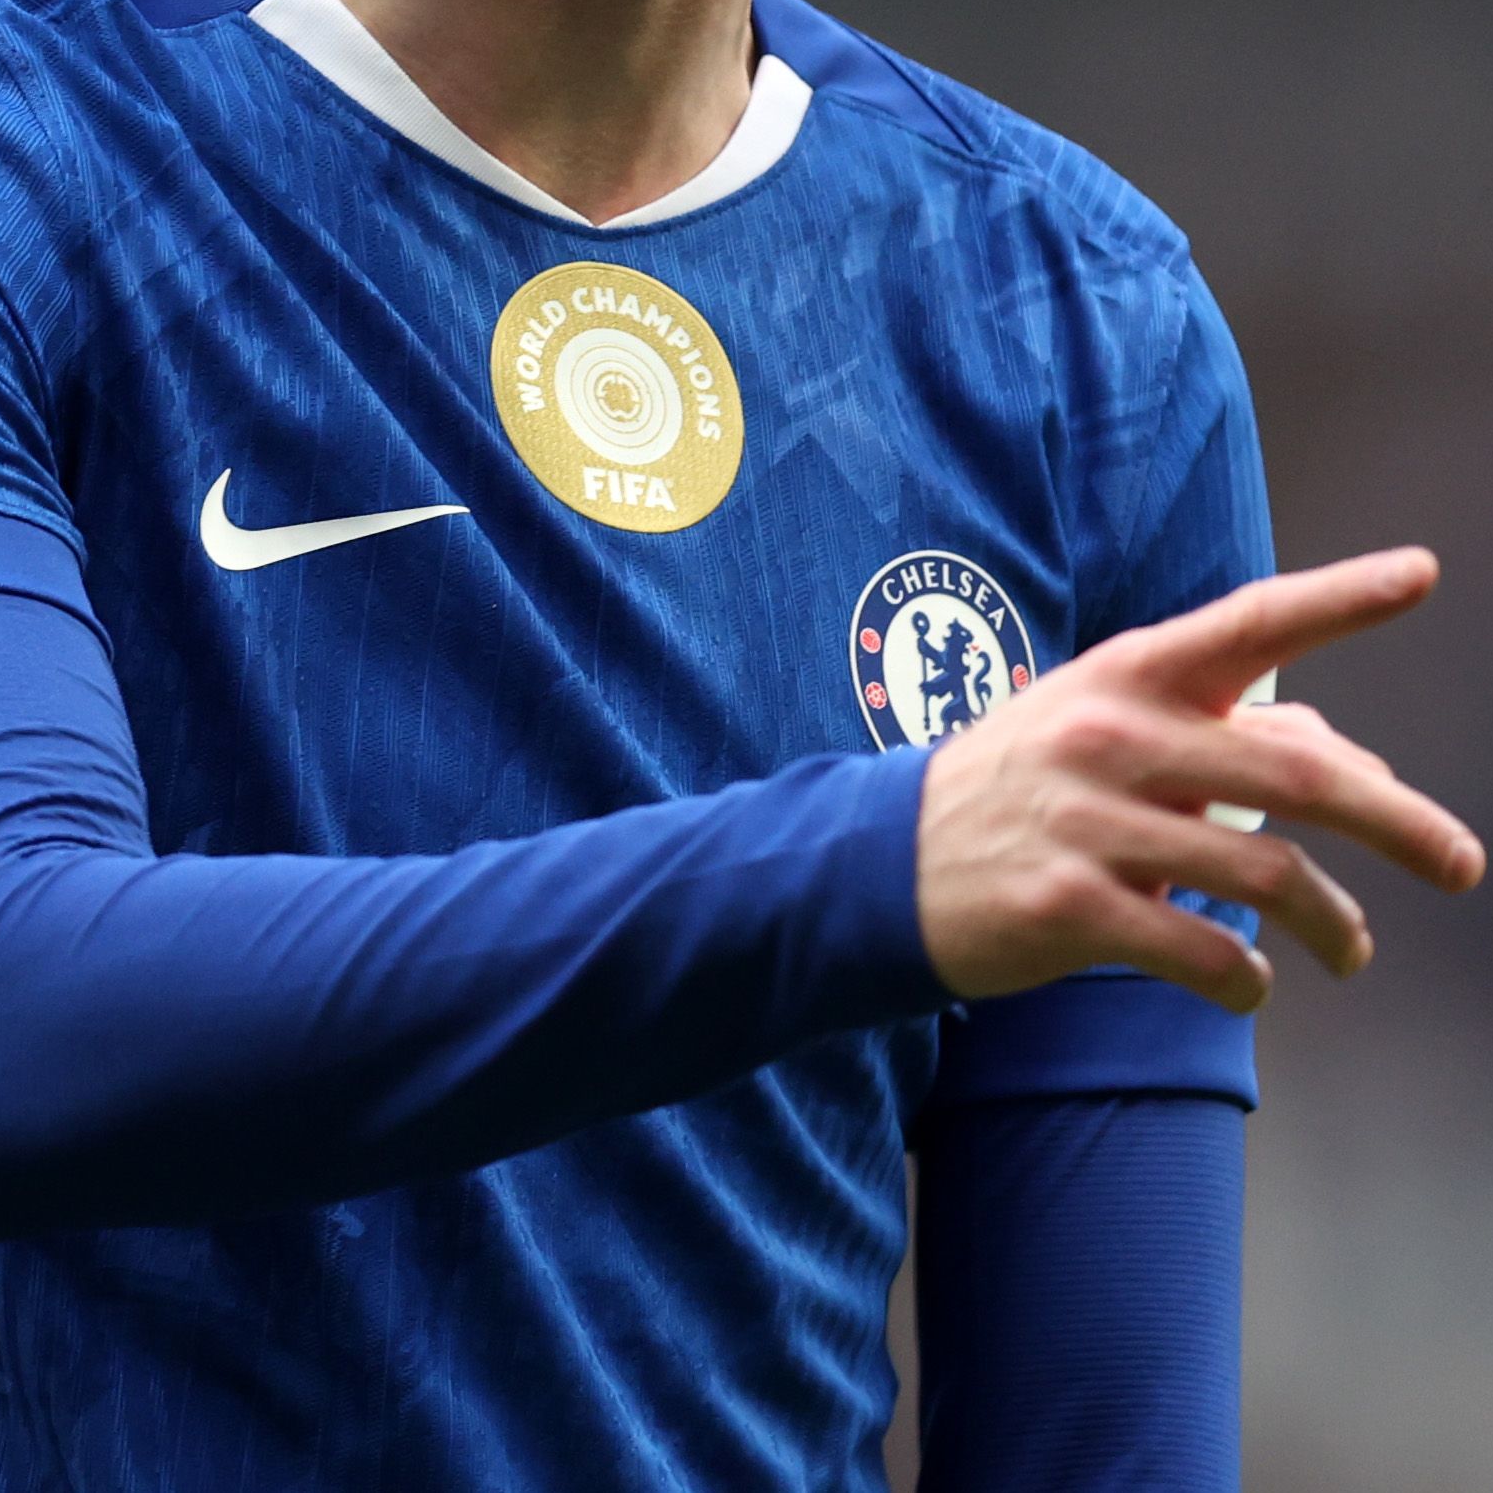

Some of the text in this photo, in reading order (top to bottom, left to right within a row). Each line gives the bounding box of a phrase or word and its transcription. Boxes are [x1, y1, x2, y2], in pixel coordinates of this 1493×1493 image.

[516, 287, 721, 441] WORLD CHAMPIONS
[583, 467, 677, 512] FIFA
[881, 562, 1005, 631] CHELSEA
